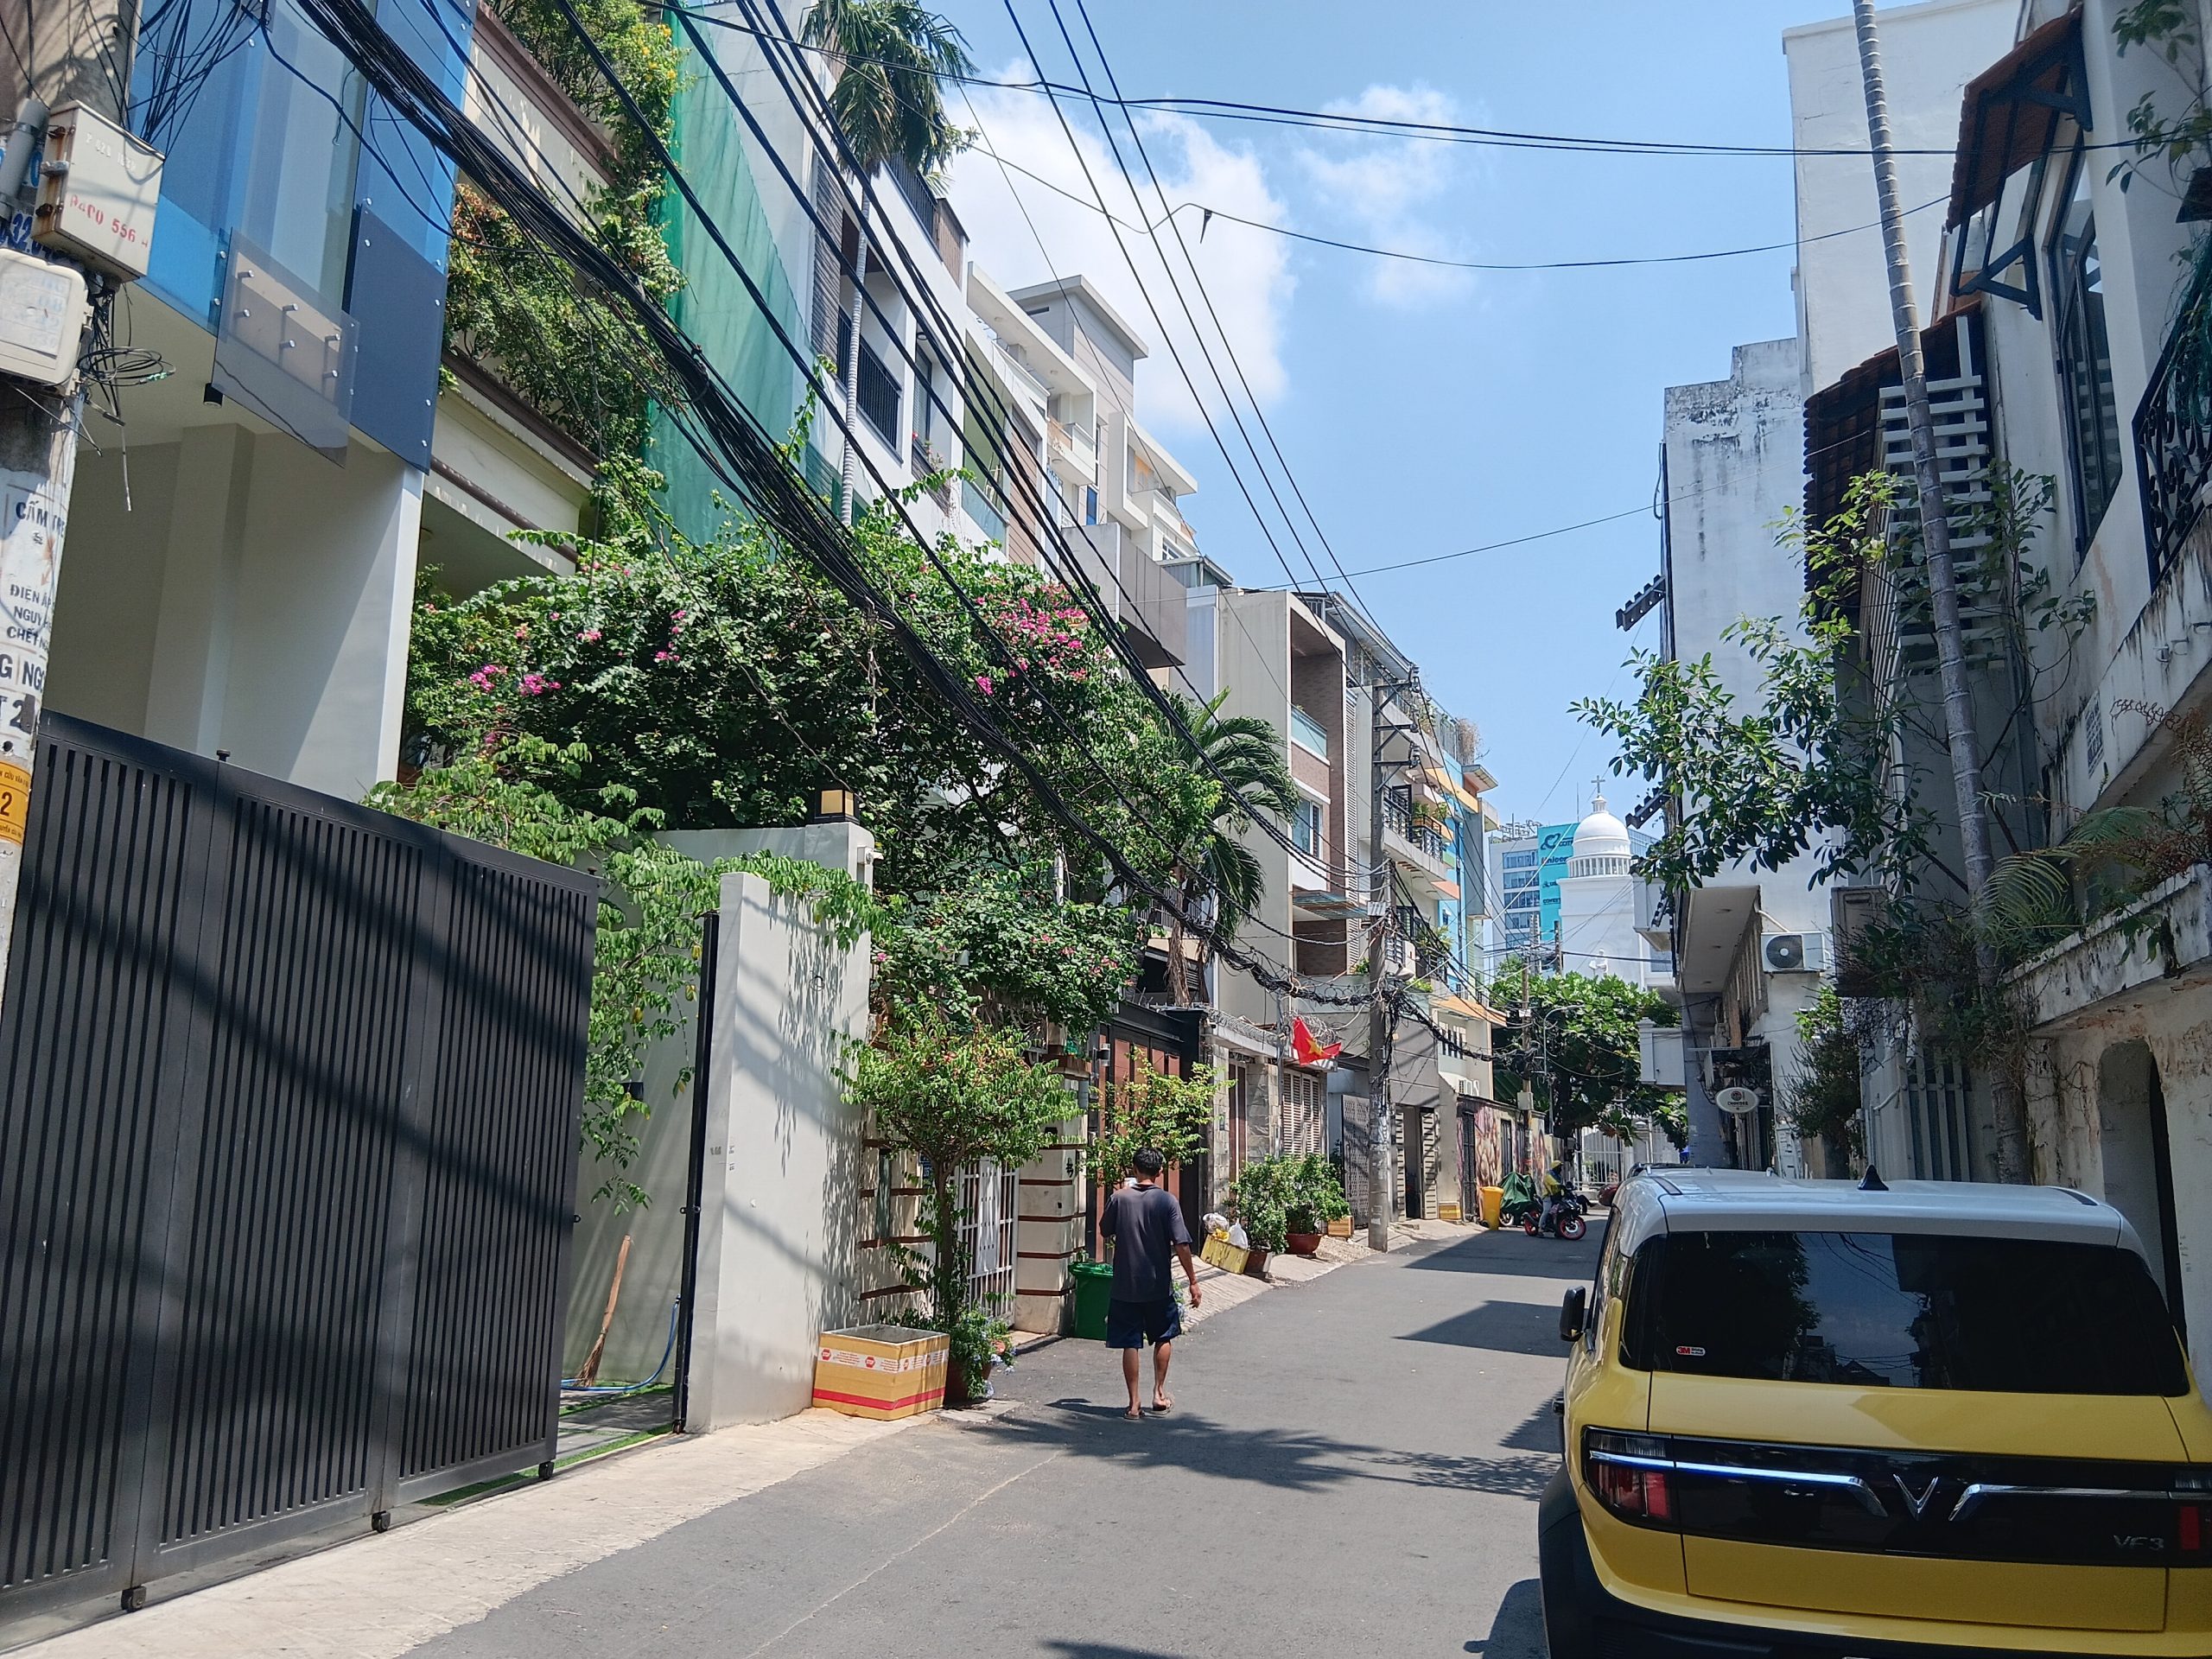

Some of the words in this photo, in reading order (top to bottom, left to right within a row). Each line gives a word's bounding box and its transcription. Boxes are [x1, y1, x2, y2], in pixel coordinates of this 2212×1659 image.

[111, 218, 136, 243] 556
[14, 606, 42, 626] NGUY
[0, 791, 12, 817] 2
